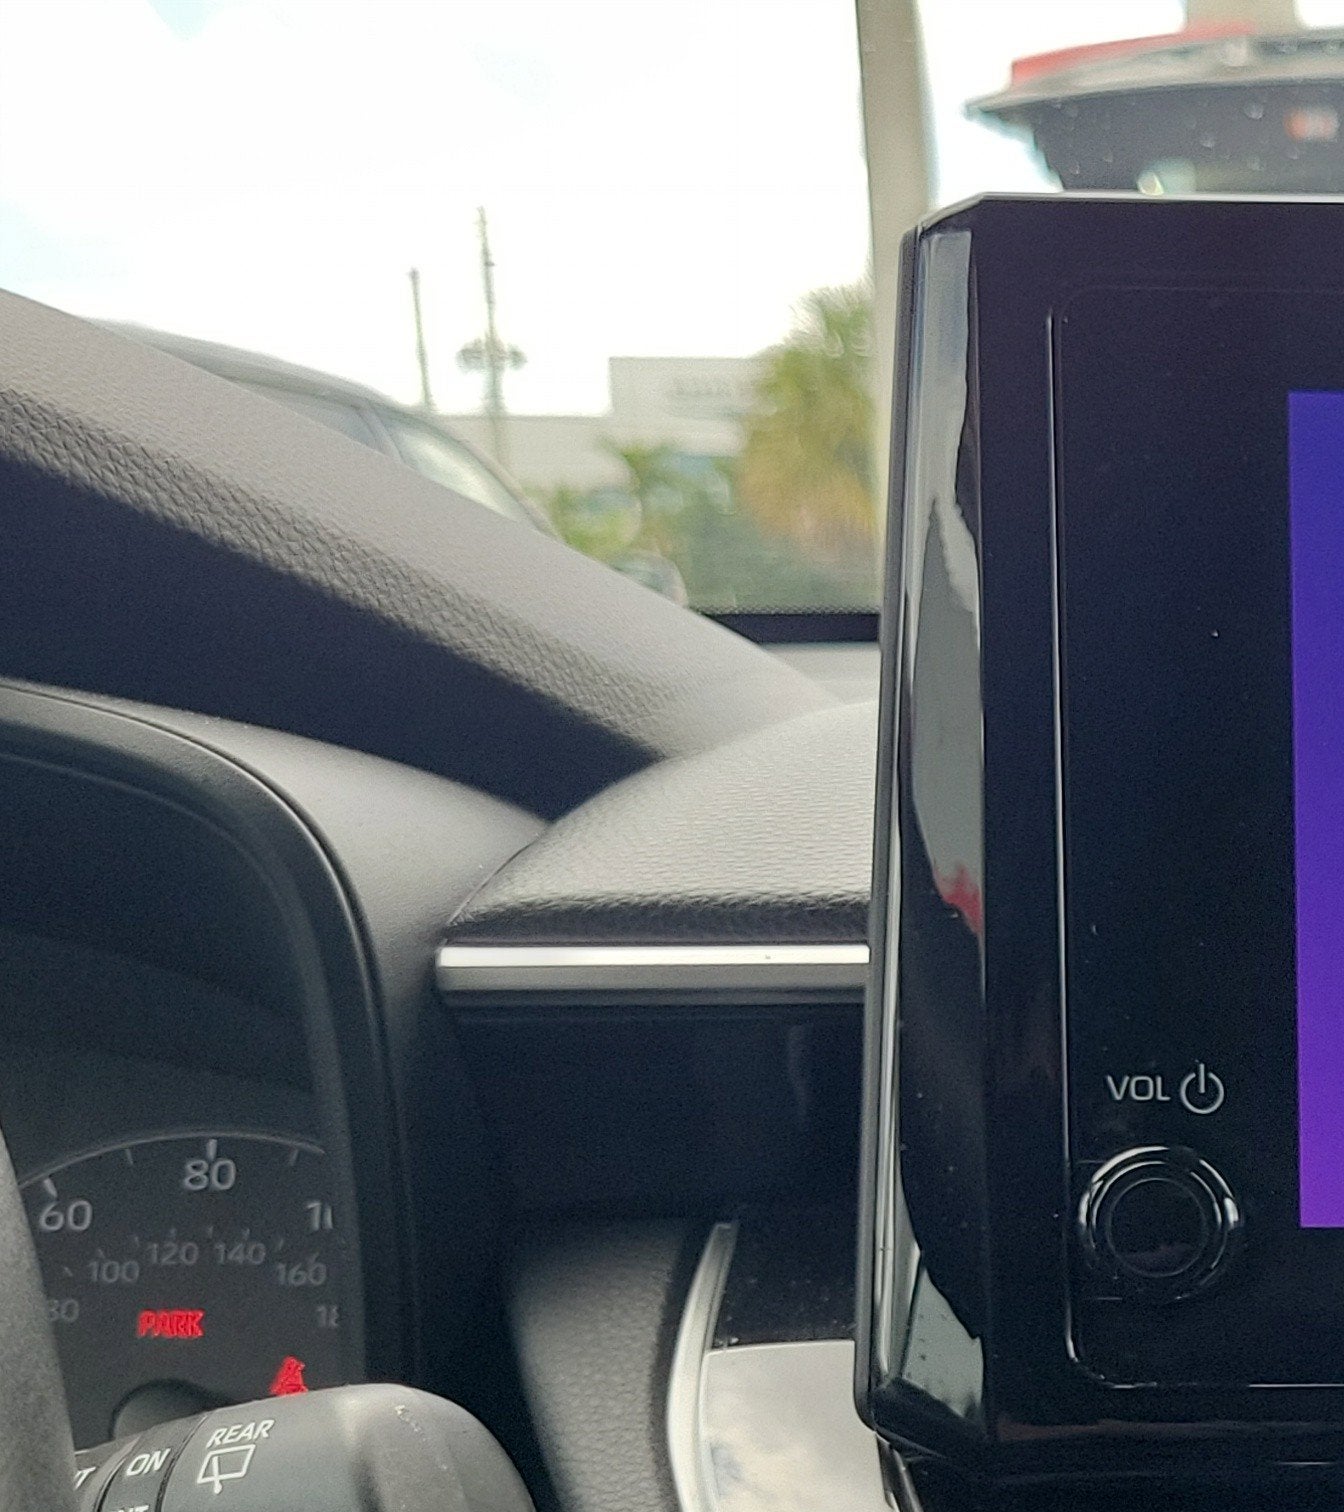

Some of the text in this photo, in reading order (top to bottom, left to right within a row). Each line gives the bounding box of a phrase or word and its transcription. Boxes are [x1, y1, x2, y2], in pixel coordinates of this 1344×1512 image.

[1106, 1075, 1171, 1102] VOL
[184, 1158, 237, 1190] 80
[38, 1199, 93, 1232] 60
[150, 1243, 199, 1265] 120
[215, 1243, 266, 1265] 140
[89, 1260, 140, 1284] 100
[276, 1261, 327, 1286] 160
[137, 1309, 205, 1338] PARK
[206, 1419, 275, 1449] REAR
[126, 1448, 171, 1476] ON
